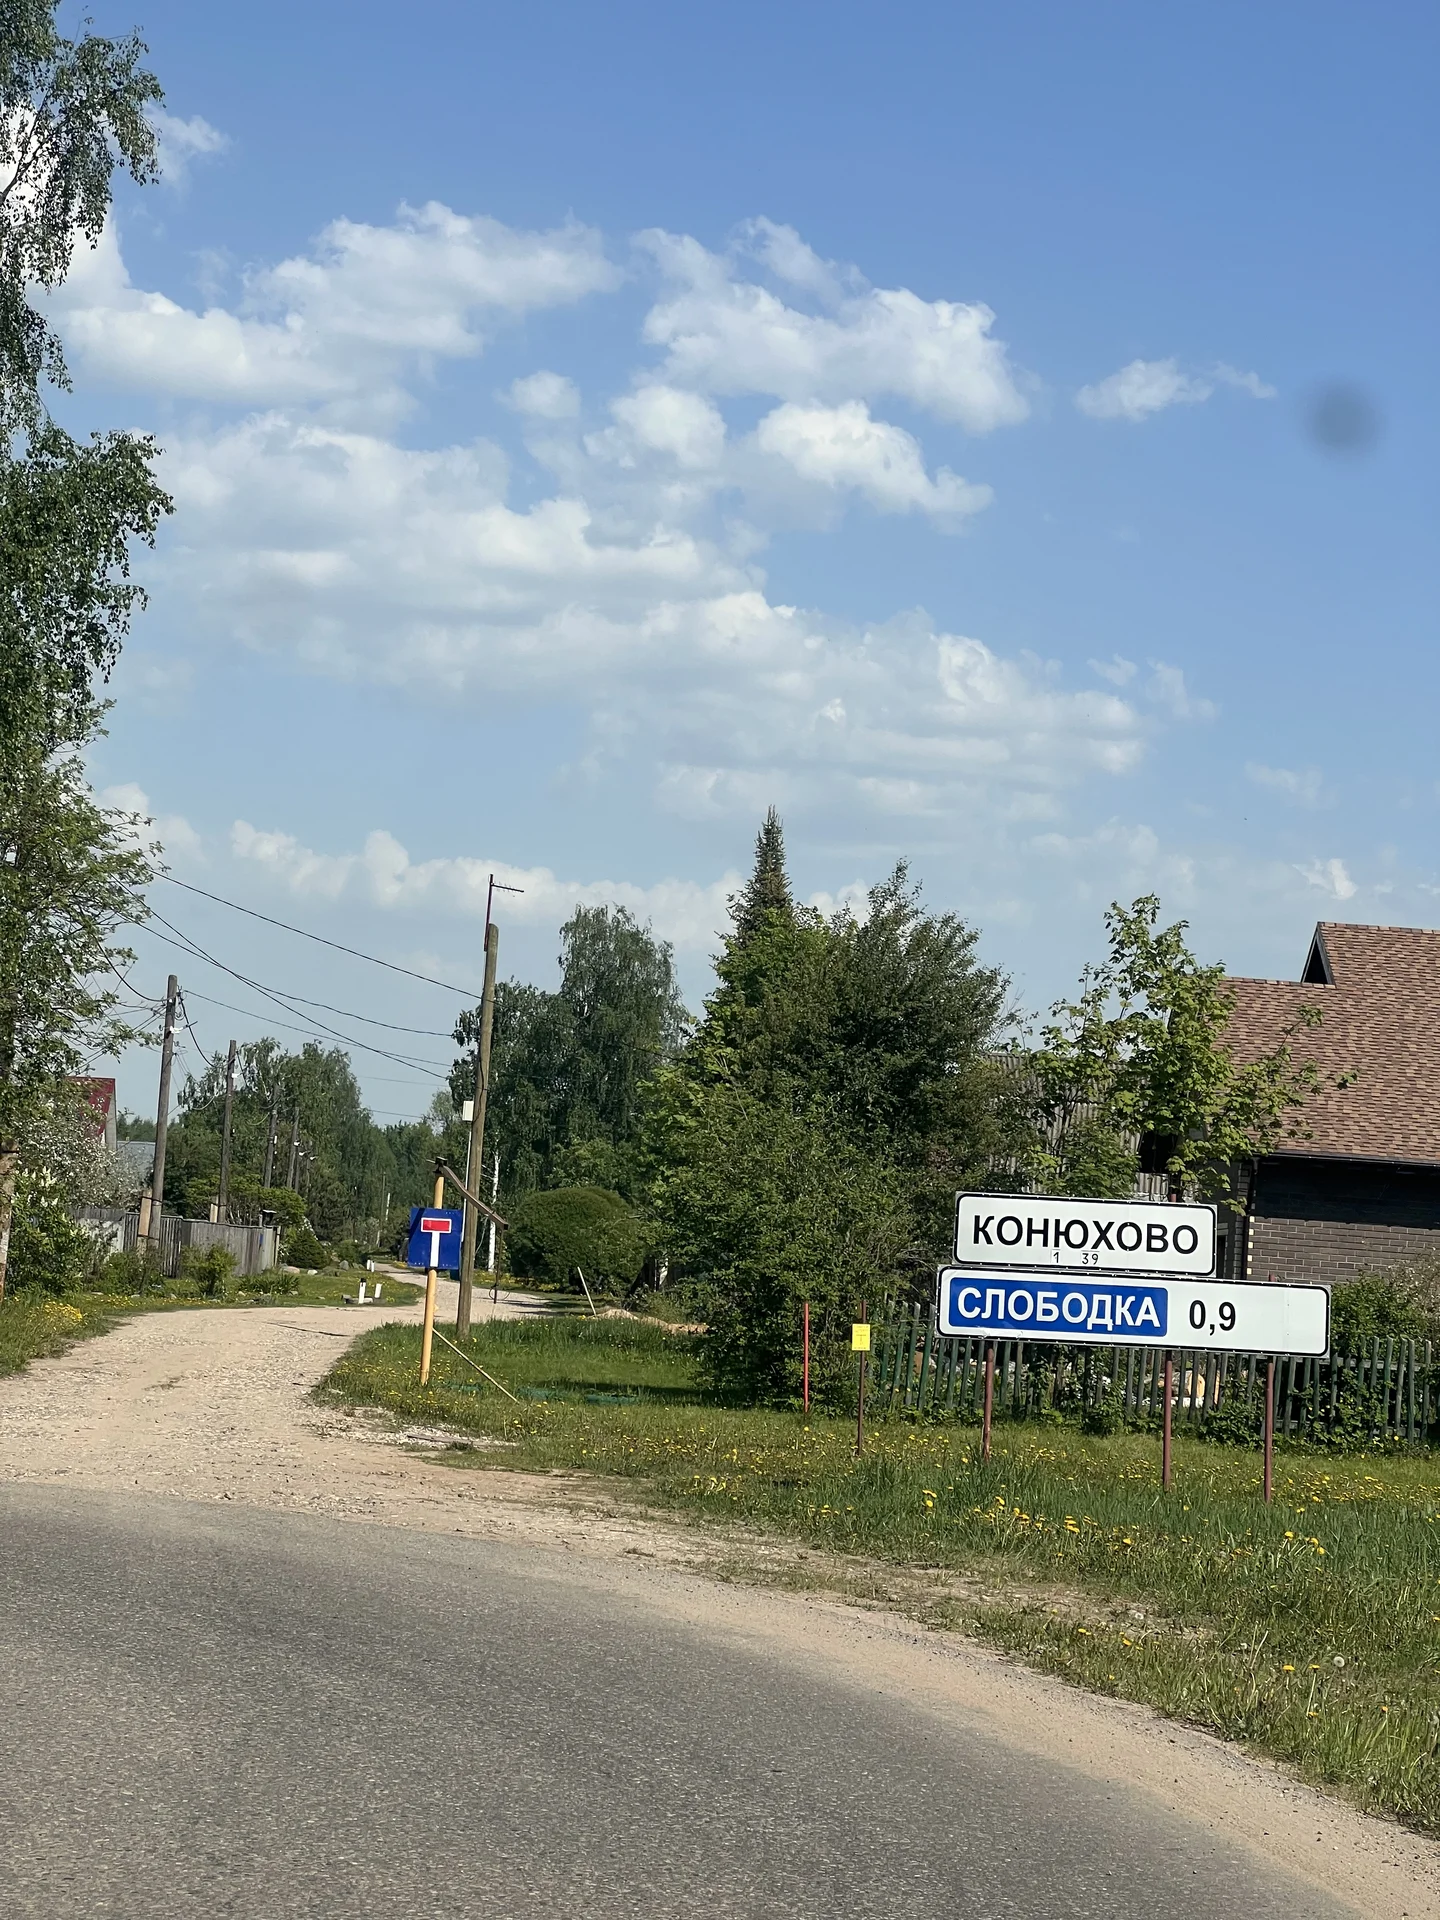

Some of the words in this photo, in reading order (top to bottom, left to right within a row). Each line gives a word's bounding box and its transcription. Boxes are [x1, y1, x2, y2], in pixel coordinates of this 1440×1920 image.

[973, 1214, 1199, 1254] КОНЮХОВО
[1053, 1252, 1060, 1263] 1
[1082, 1253, 1099, 1265] 39
[957, 1286, 1162, 1331] СЛОБОДКА
[1189, 1300, 1236, 1335] 0,9
